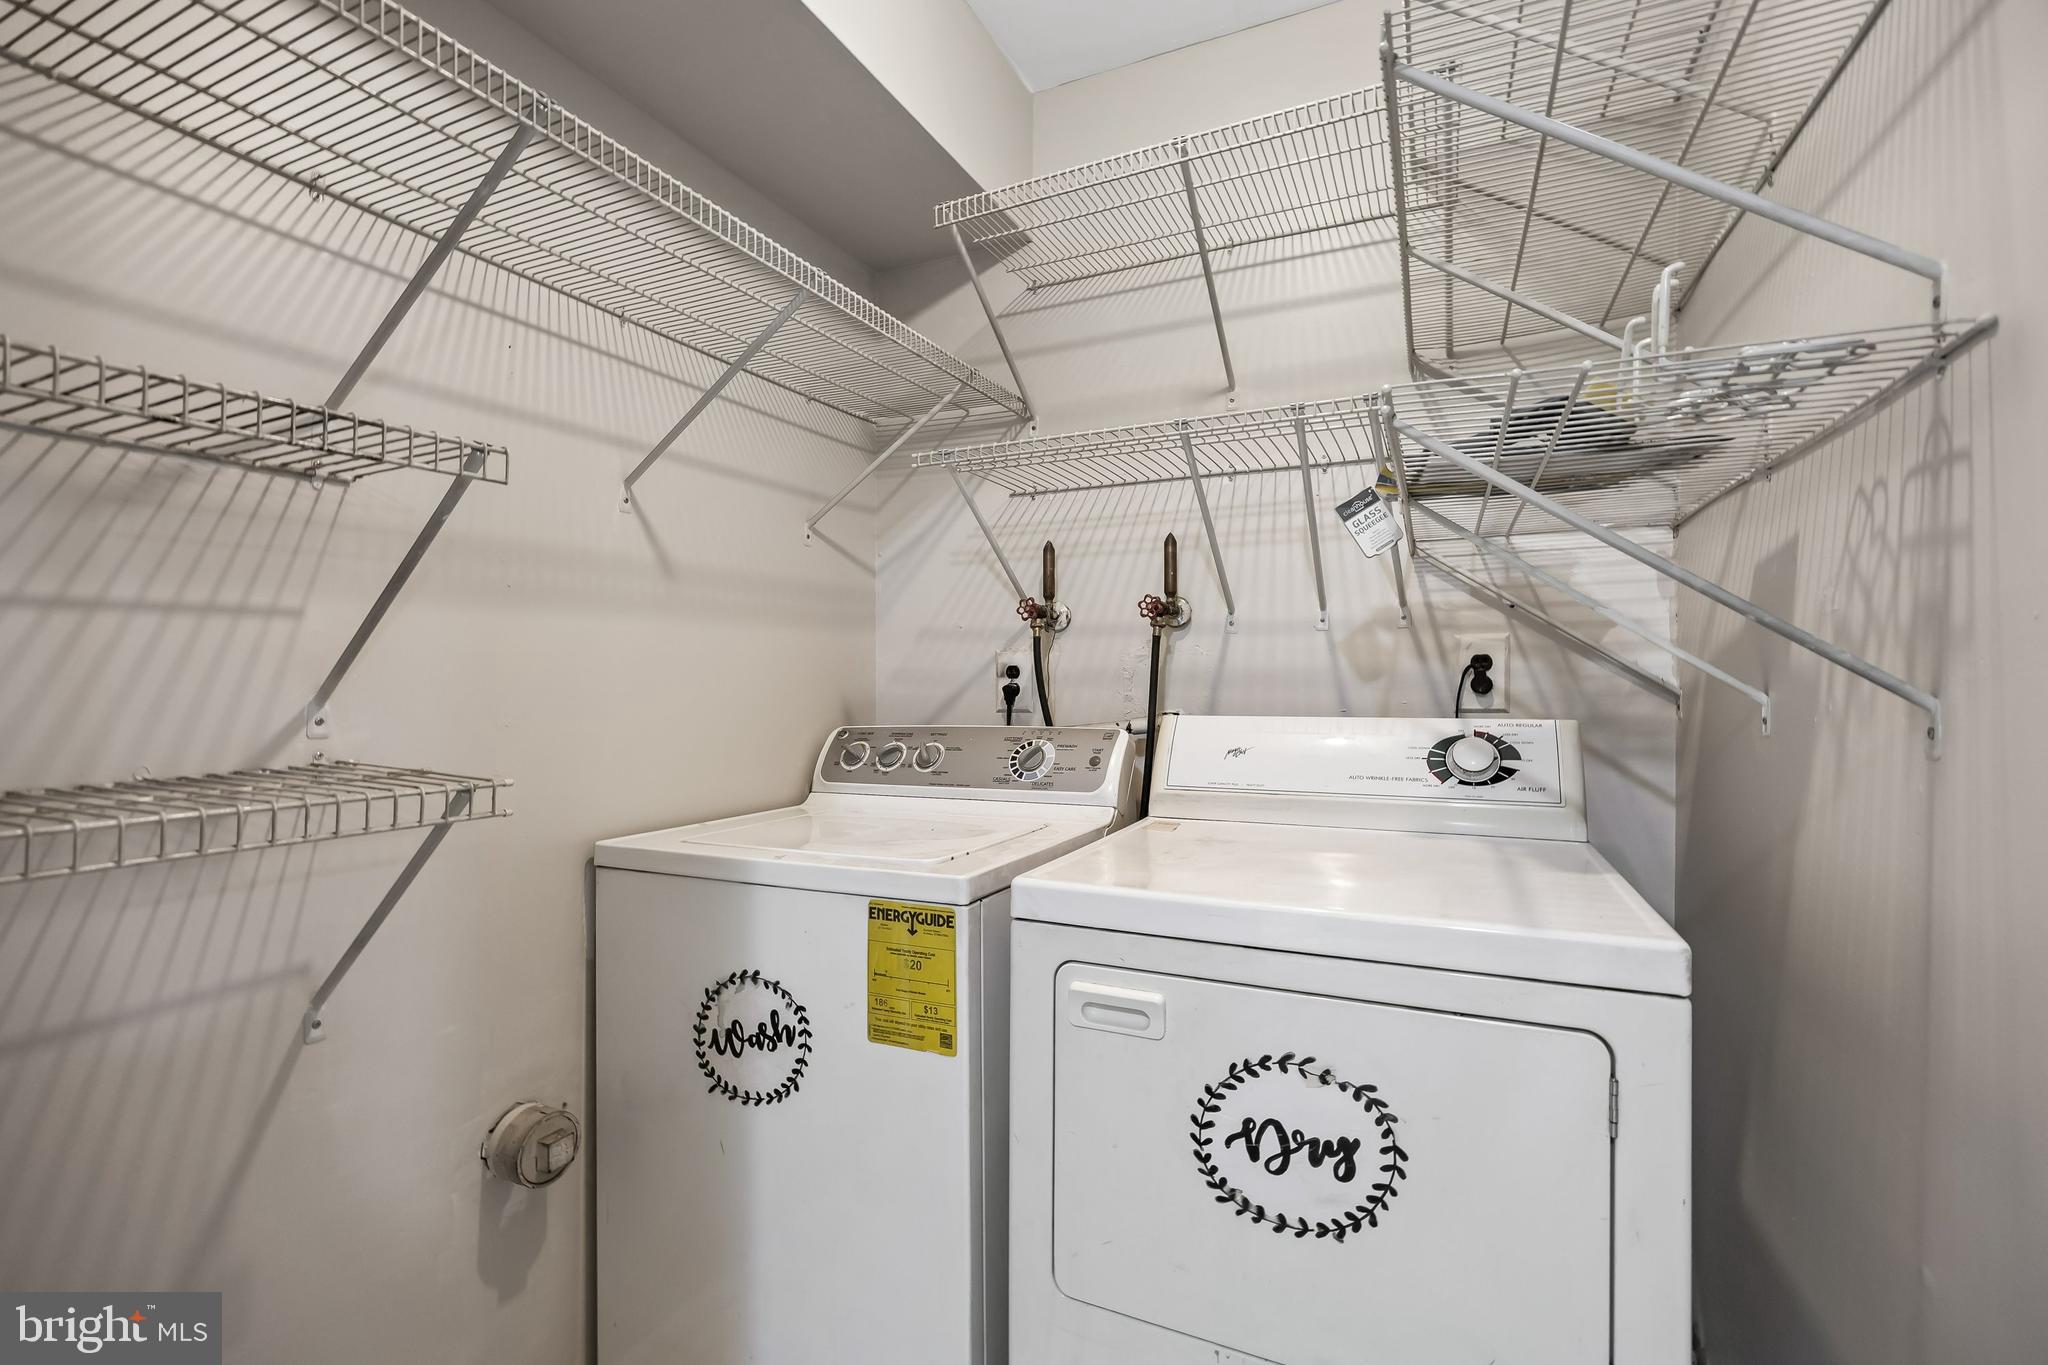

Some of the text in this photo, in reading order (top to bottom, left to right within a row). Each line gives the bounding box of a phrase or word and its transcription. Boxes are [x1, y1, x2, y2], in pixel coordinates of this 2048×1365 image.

[1352, 506, 1382, 528] GLASS
[1354, 511, 1389, 537] SQUEEGEE
[869, 906, 955, 930] ENERGYGUIDE
[874, 998, 889, 1007] 186
[923, 1005, 938, 1016] $13
[707, 1009, 796, 1059] Wash
[1224, 1116, 1361, 1183] Dry
